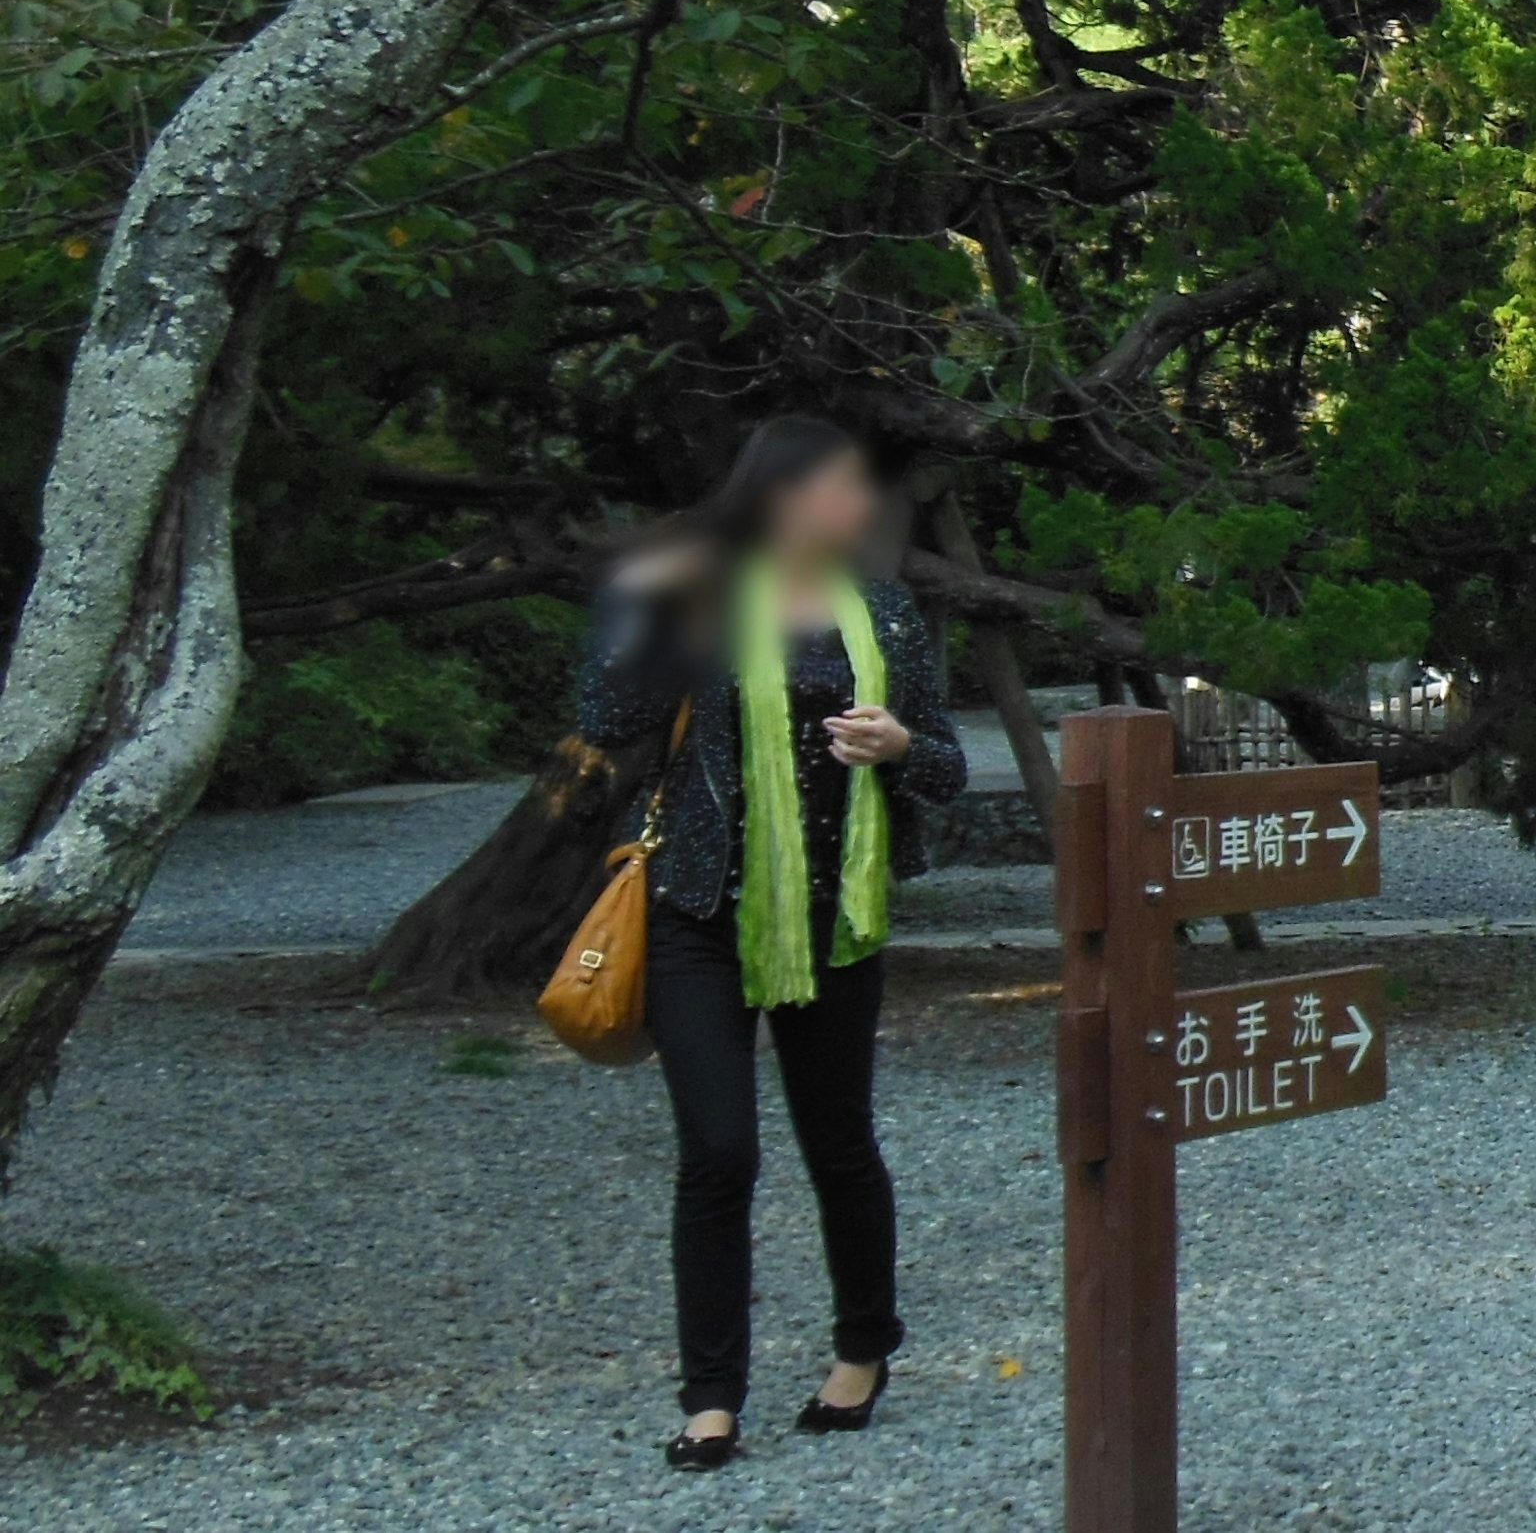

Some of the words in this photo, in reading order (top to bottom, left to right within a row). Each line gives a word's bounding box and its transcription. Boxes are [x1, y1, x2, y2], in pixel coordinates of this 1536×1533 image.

[1219, 810, 1319, 873] 車椅子
[1176, 993, 1322, 1066] お手洗
[1176, 1055, 1322, 1127] TOILET
